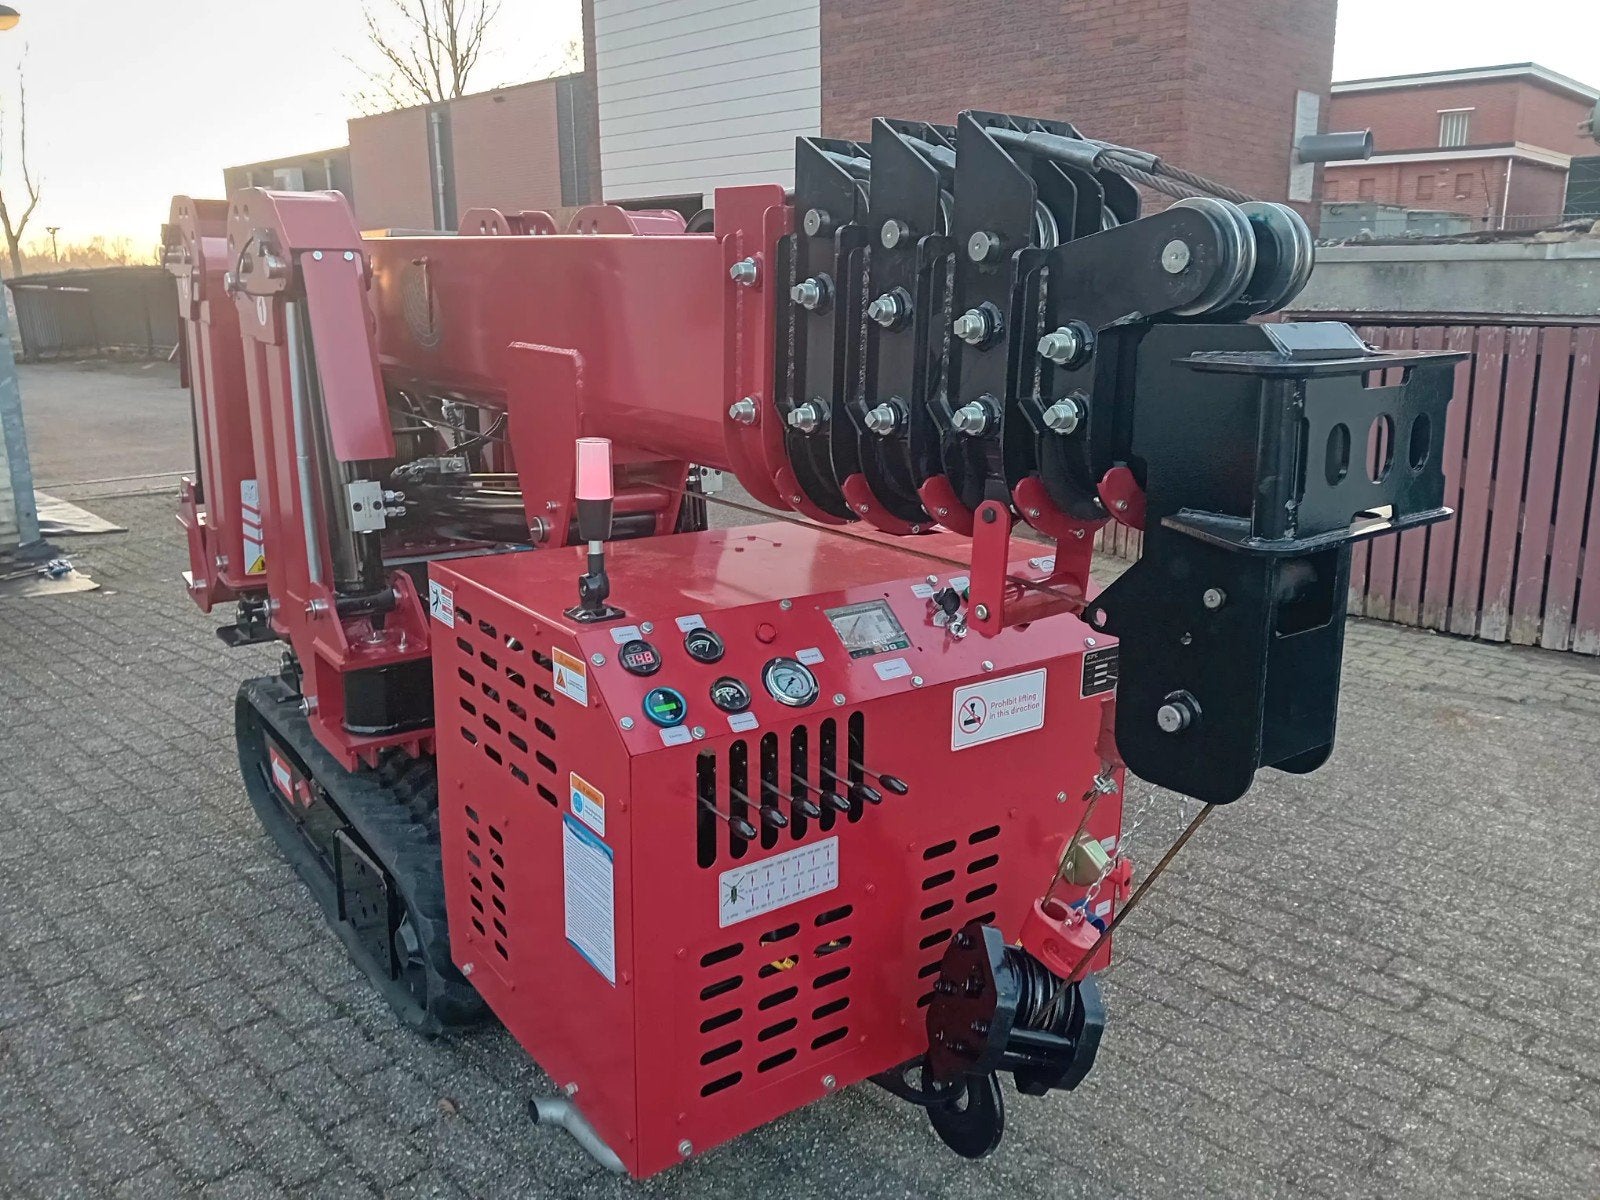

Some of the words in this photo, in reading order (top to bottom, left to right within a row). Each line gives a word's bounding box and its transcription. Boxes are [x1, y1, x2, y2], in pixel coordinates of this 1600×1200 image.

[991, 697, 1017, 709] Prohibit
[1018, 693, 1037, 702] lifting
[989, 712, 995, 720] in
[997, 709, 1010, 717] this
[1011, 702, 1040, 714] direction
